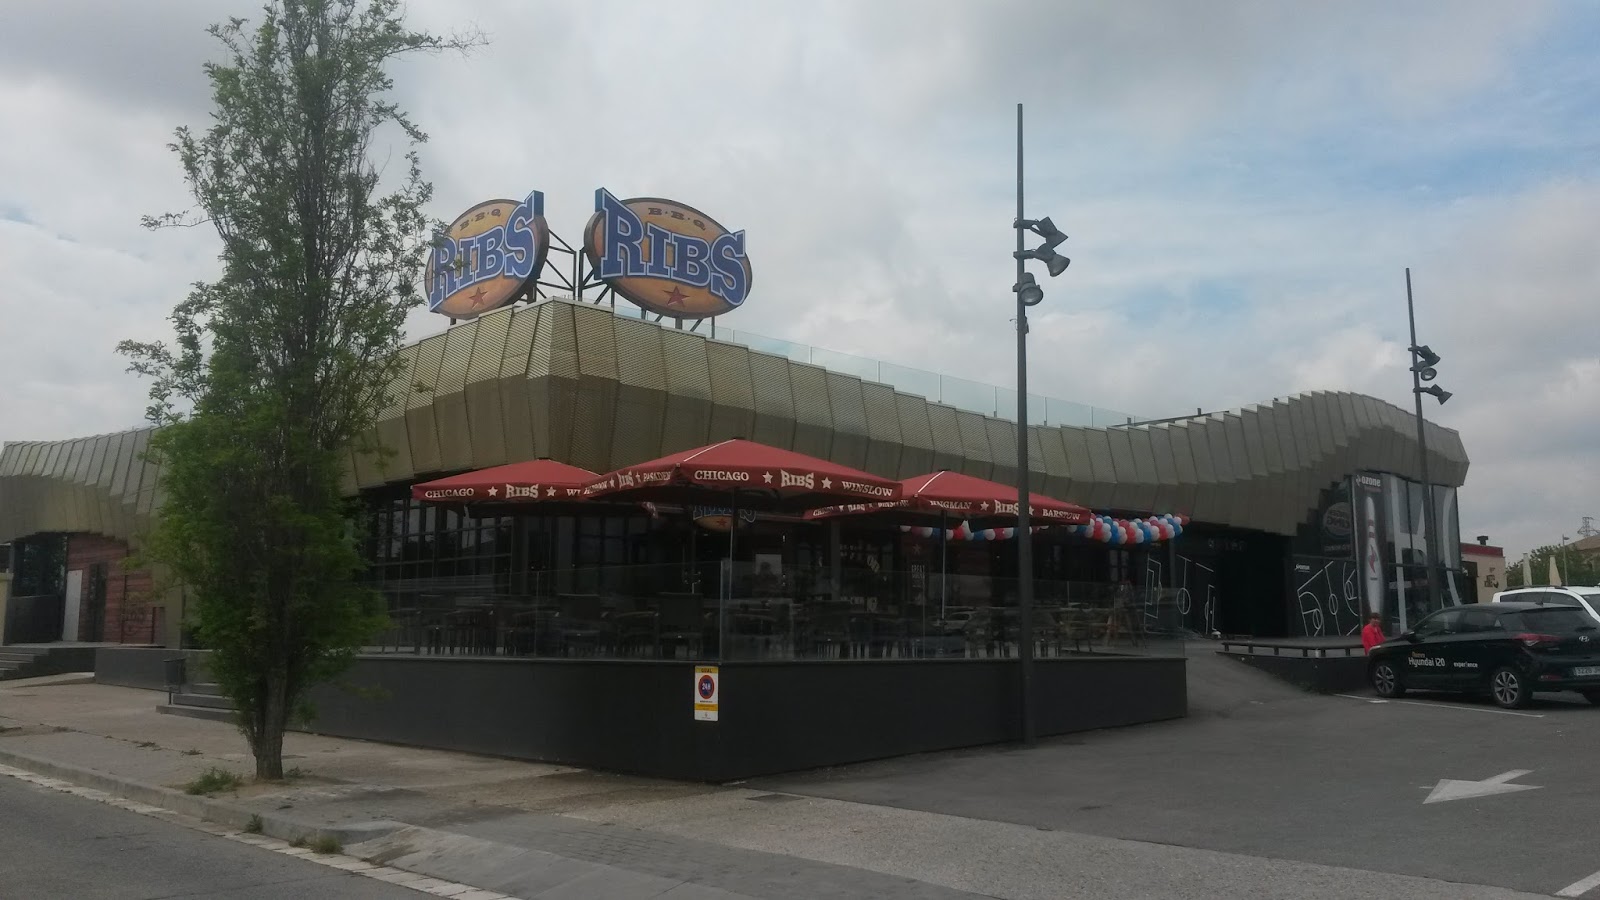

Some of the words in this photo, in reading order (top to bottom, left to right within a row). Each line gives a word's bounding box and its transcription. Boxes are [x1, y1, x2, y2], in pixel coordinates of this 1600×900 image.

[429, 189, 537, 313] RIBS
[600, 187, 746, 305] RIBS
[643, 471, 673, 482] PASADEN
[694, 470, 750, 482] CHICAGO
[780, 469, 815, 489] RIBS
[841, 481, 893, 497] WINSLOW
[424, 487, 475, 498] CHICAGO
[505, 484, 540, 499] RIBS
[994, 499, 1020, 516] RIBS
[1042, 508, 1081, 520] BARSTOW
[1408, 657, 1434, 667] Hyundai
